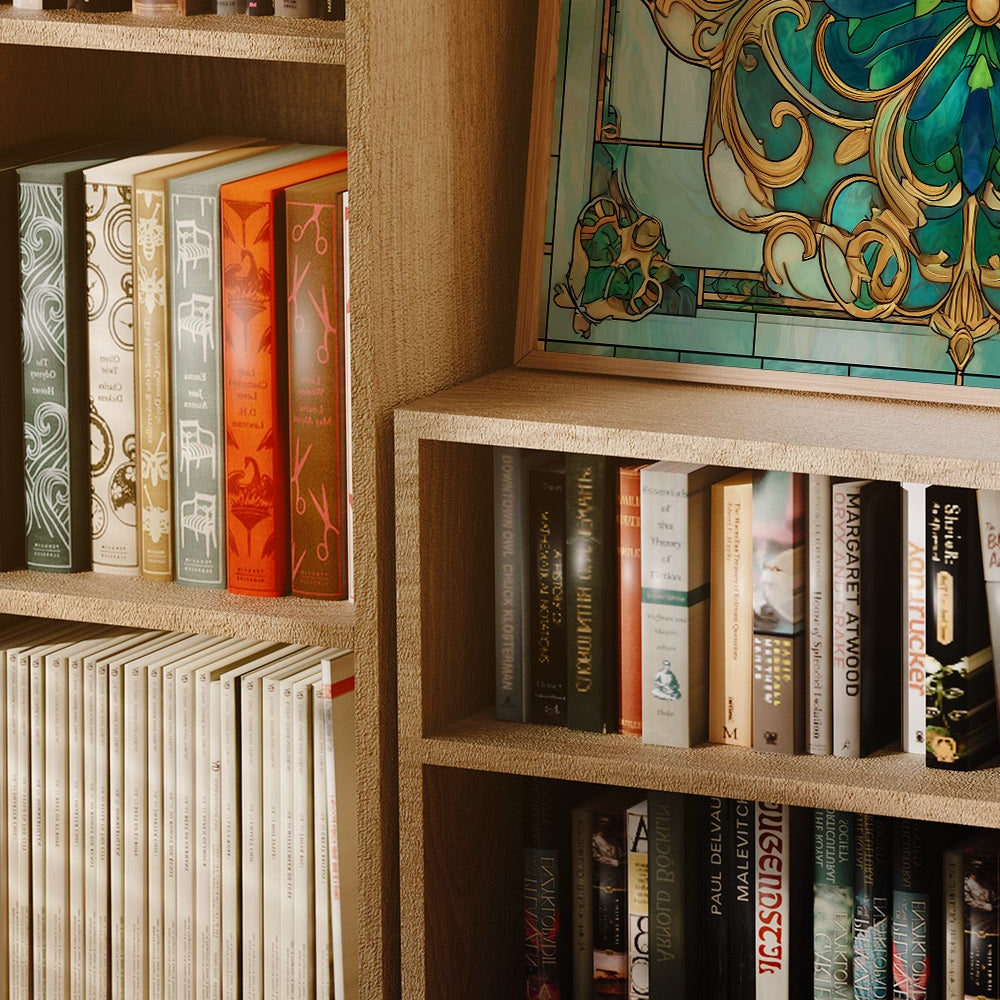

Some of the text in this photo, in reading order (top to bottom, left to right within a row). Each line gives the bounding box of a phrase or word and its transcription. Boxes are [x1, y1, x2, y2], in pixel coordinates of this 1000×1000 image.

[651, 538, 682, 550] Theory
[833, 491, 846, 669] ORYX AND CRAKE
[846, 492, 860, 697] MARGARET ATWOOD
[813, 590, 823, 623] House
[709, 798, 723, 916] PAUL DELVAU
